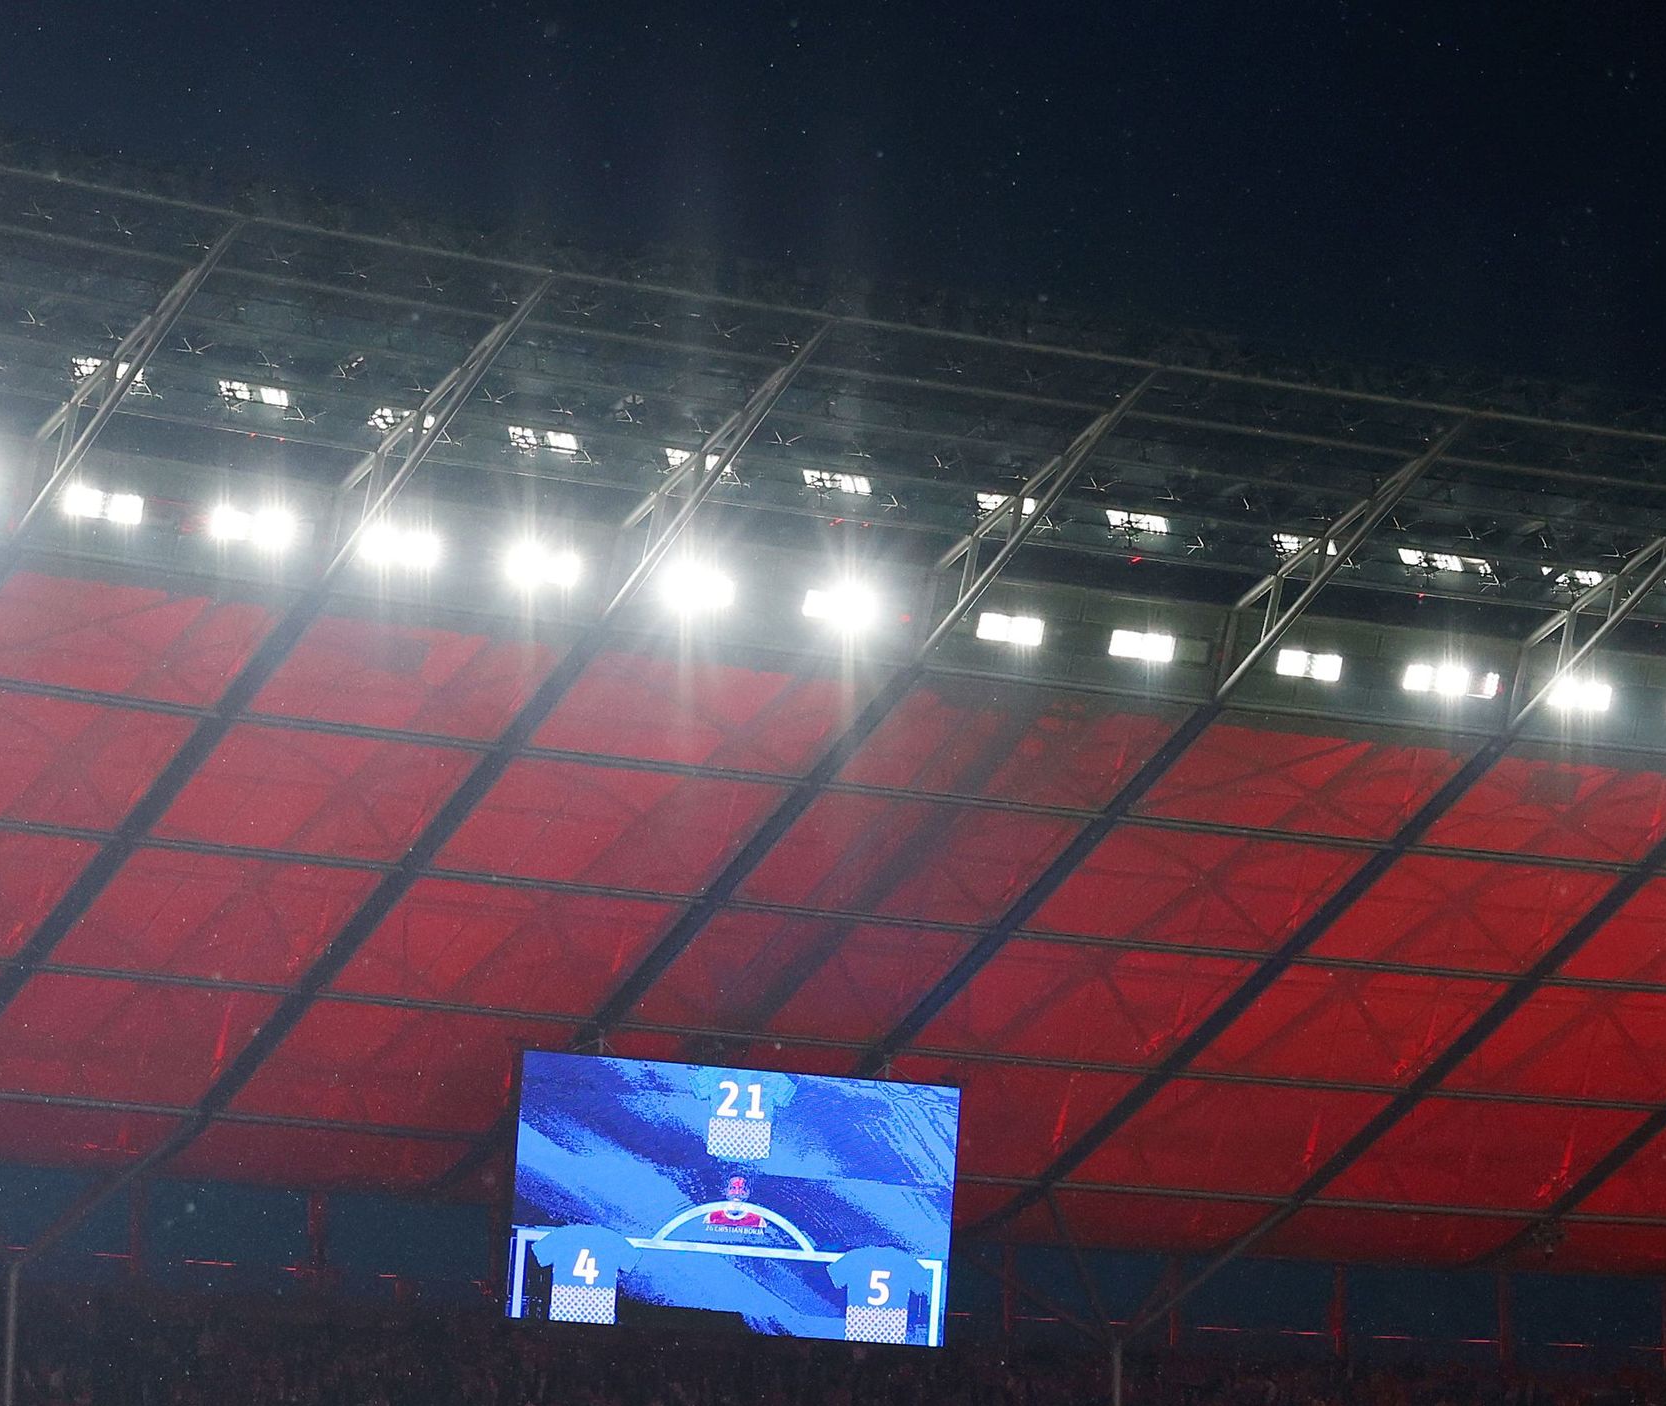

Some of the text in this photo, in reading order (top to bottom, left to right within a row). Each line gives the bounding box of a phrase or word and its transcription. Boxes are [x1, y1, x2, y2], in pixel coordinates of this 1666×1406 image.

[716, 1081, 765, 1120] 21
[573, 1248, 599, 1285] 4
[867, 1270, 891, 1306] 5
